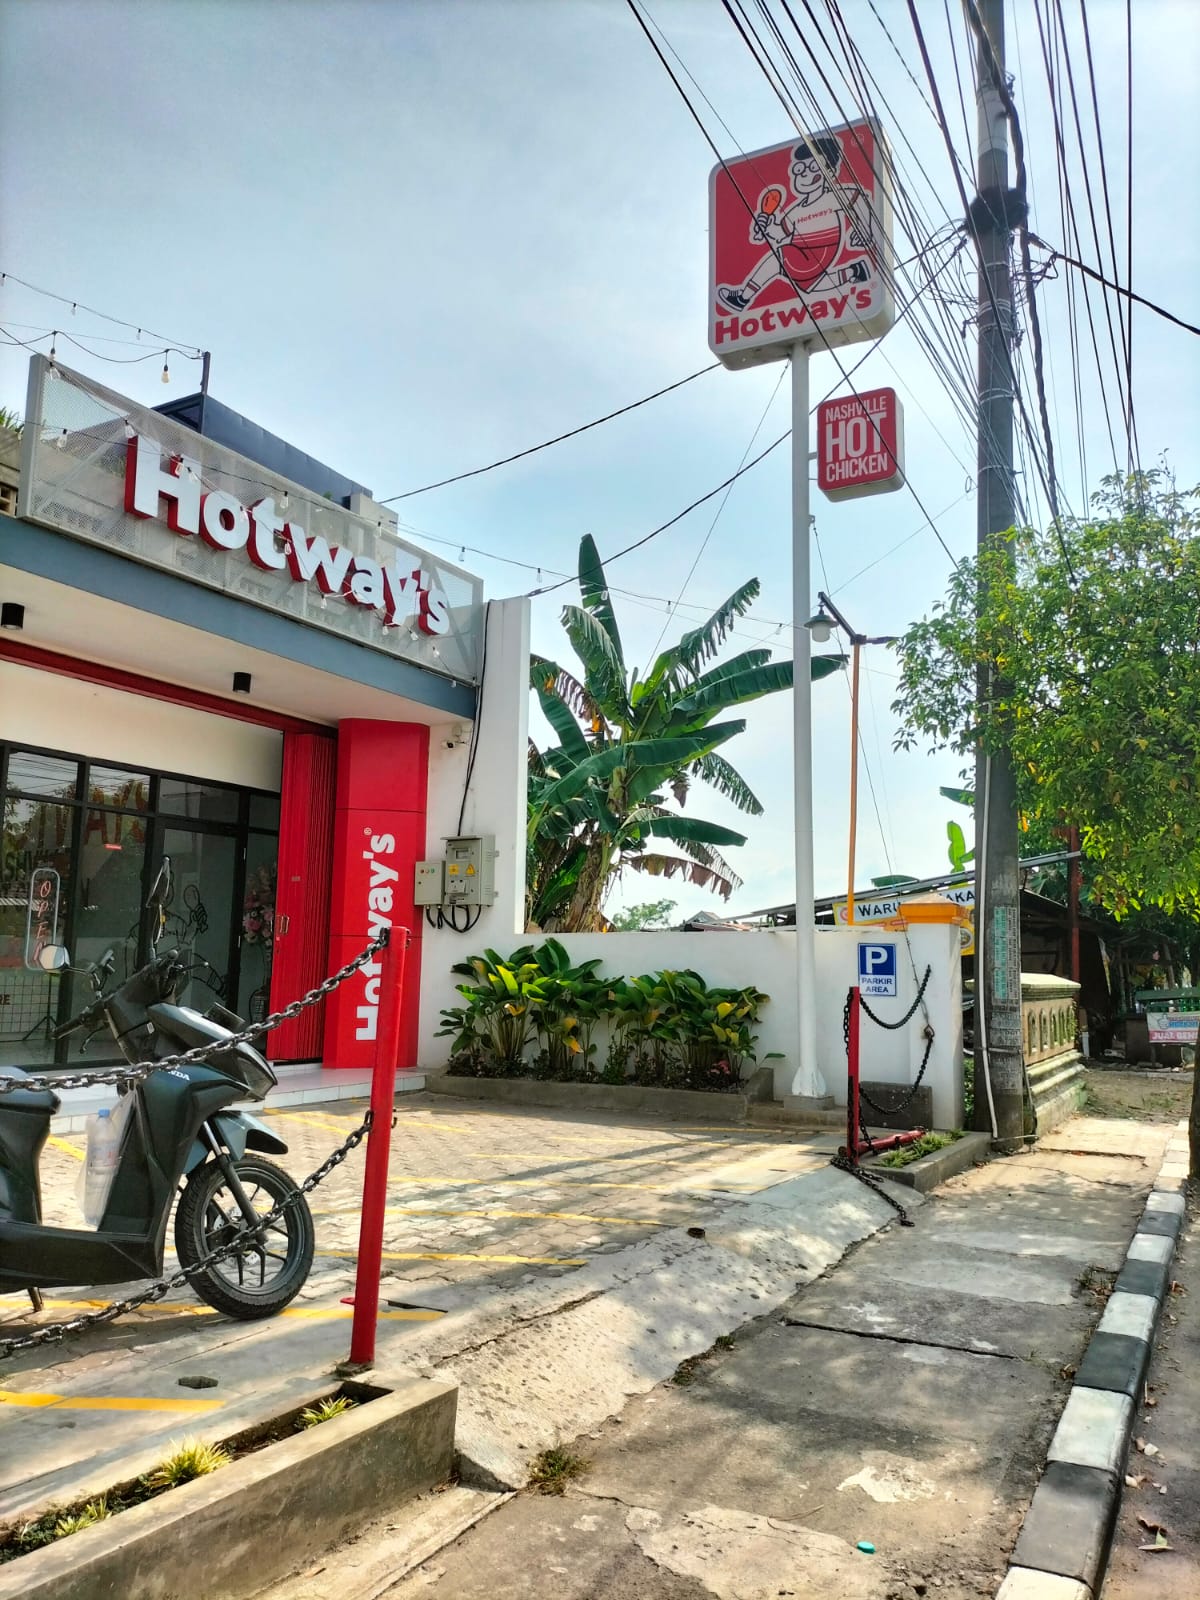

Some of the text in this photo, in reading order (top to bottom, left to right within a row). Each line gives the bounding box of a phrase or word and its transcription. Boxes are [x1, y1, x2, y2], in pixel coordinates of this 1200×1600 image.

[797, 208, 833, 224] Hotway's
[715, 287, 872, 344] Hotway's
[825, 396, 887, 422] NASHVILLE
[825, 411, 887, 462] HOT
[825, 453, 888, 482] CHICKEN
[124, 435, 450, 636] Hotway's
[865, 946, 888, 974] P
[861, 977, 893, 985] PARKIR
